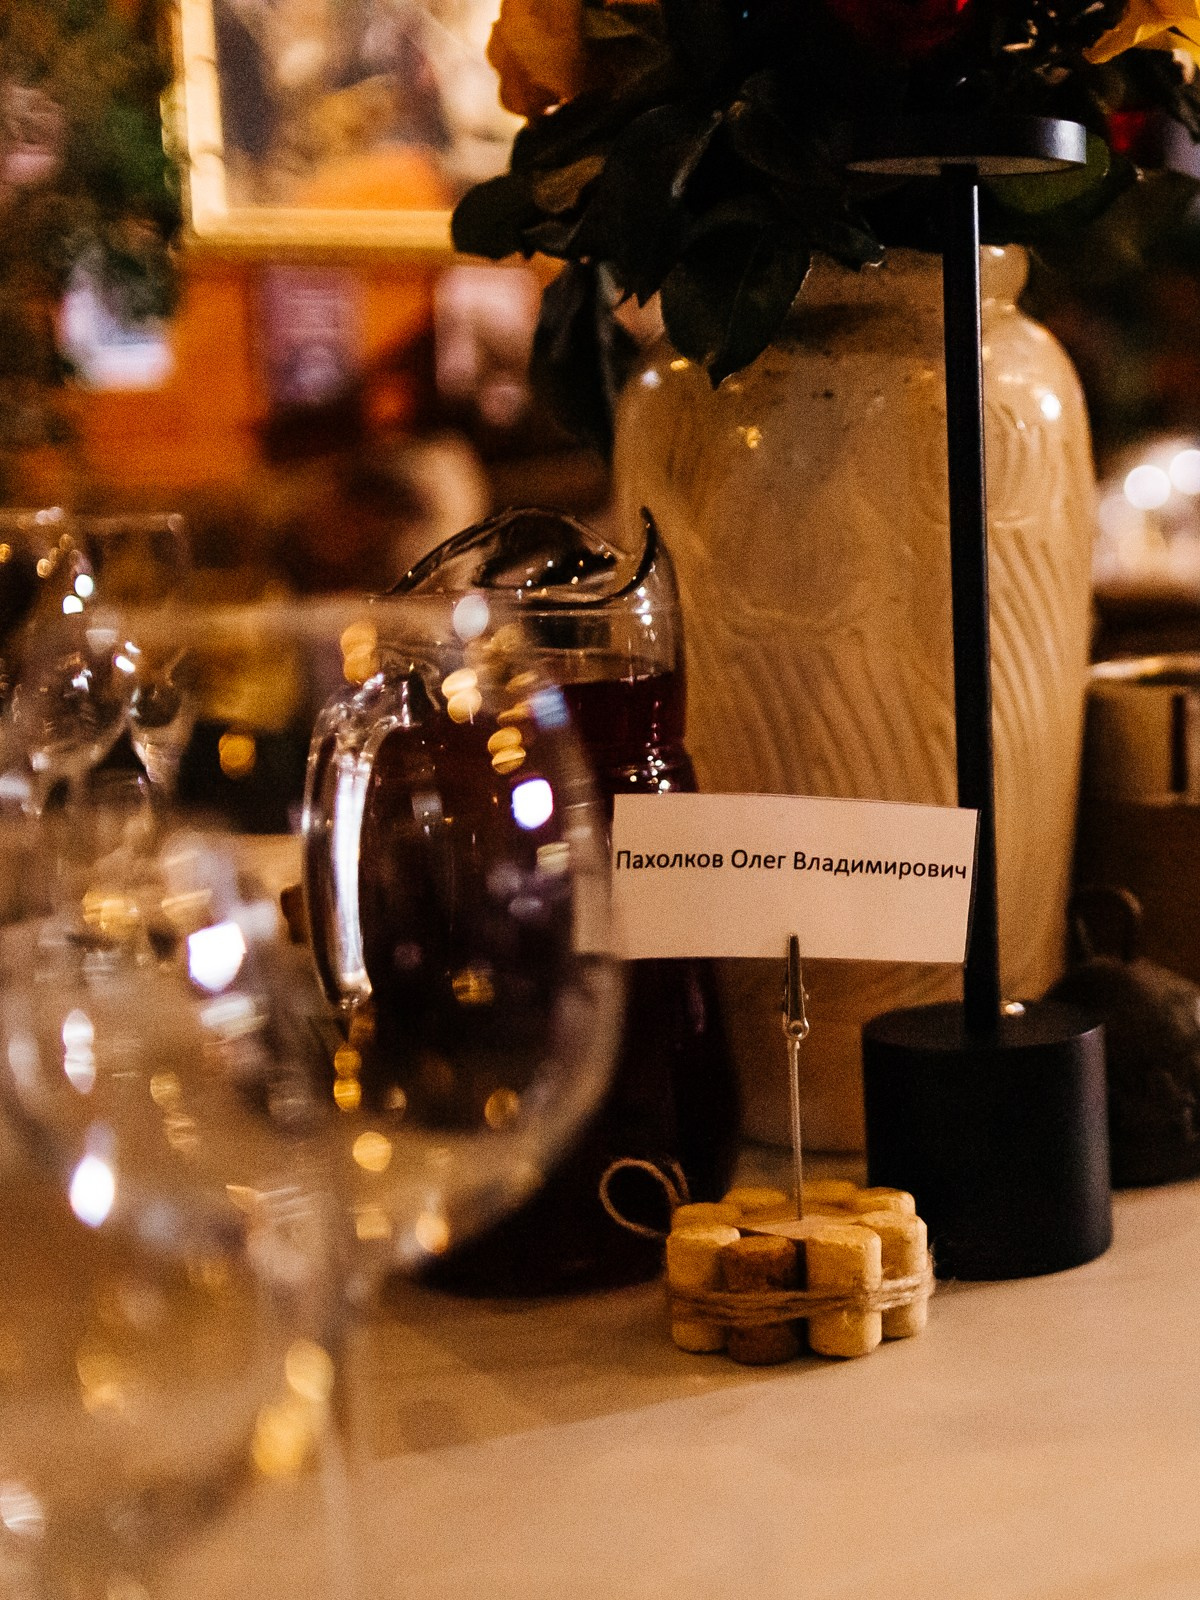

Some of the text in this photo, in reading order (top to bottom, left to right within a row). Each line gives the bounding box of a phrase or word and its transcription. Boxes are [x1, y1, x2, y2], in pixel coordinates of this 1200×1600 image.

[615, 849, 967, 880] Пахолков Олег Владимирович
